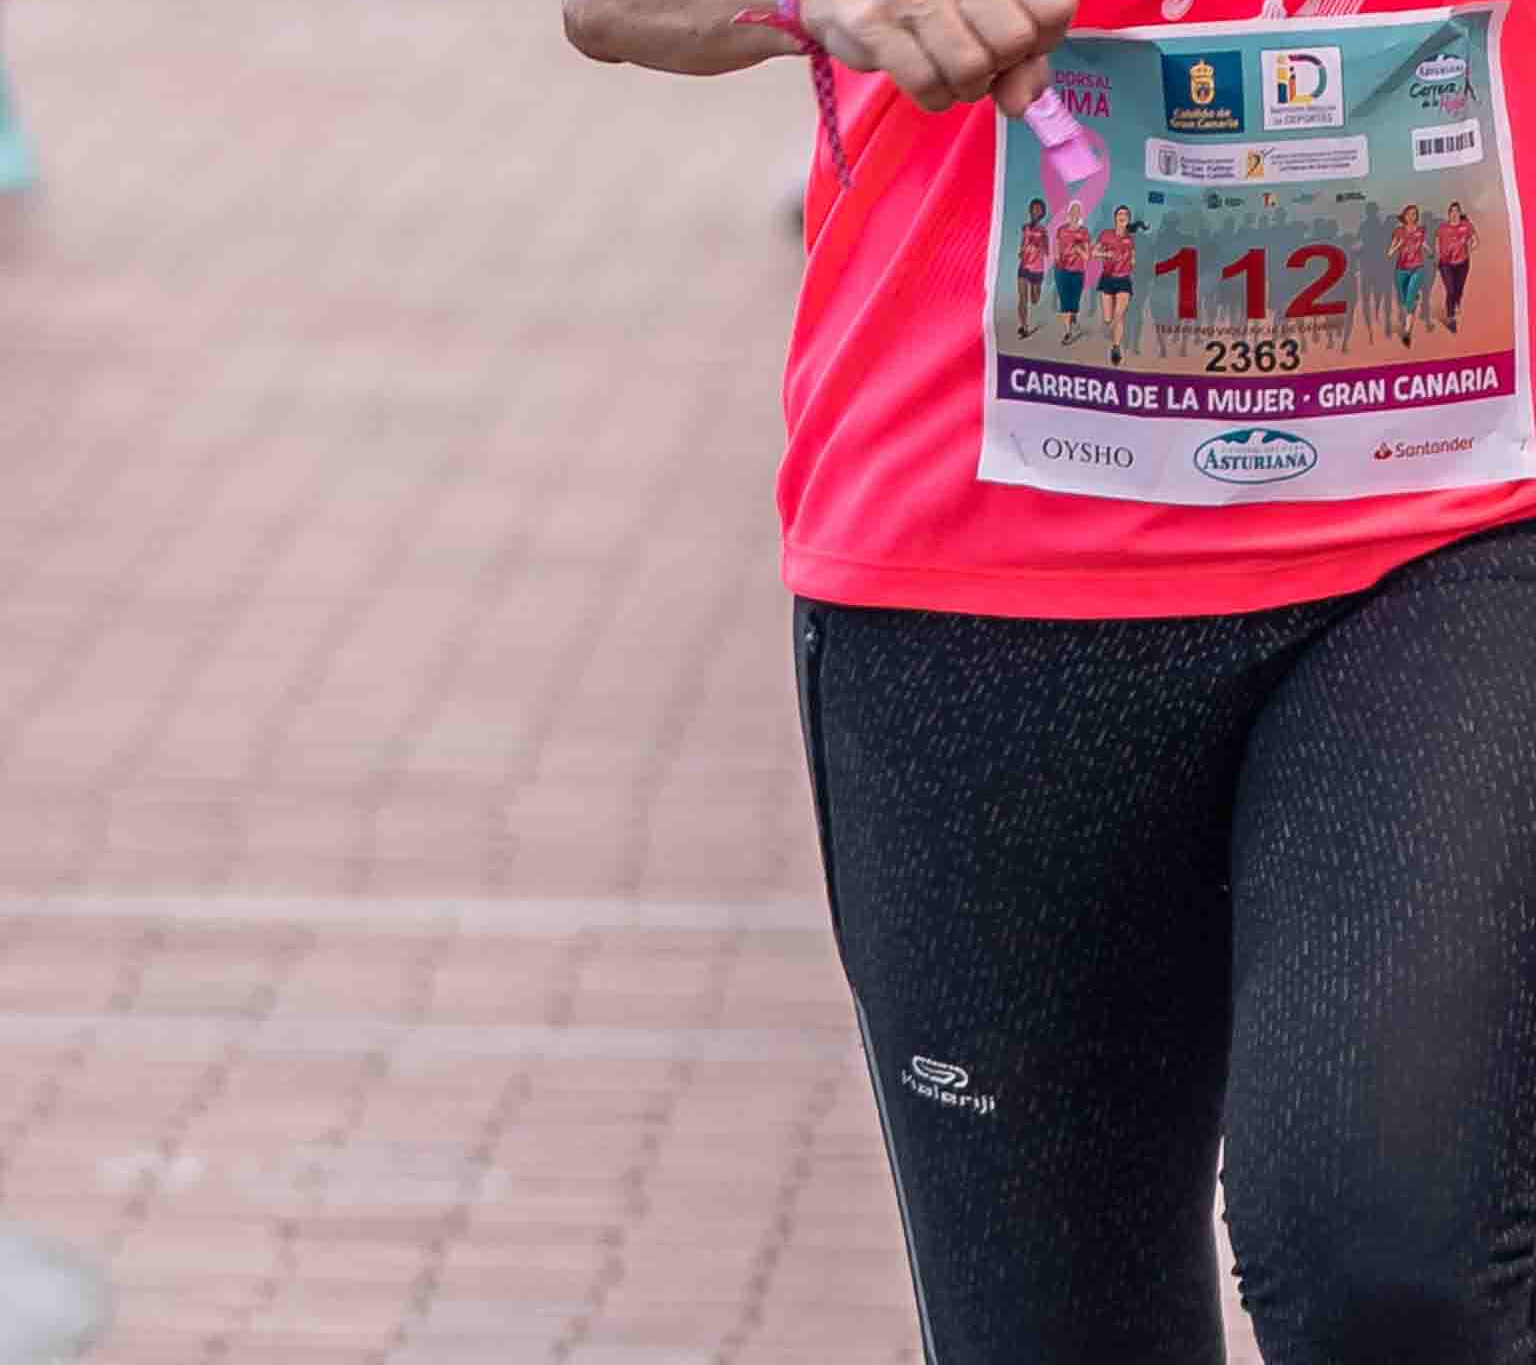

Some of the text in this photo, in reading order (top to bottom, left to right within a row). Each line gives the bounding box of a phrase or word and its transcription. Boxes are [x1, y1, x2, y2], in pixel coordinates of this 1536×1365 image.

[1156, 244, 1347, 320] 112
[1205, 340, 1300, 372] 2363
[1010, 365, 1499, 413] CARRERA DE LA MUJER GRAN CANARIA
[1042, 436, 1134, 469] OYSHO
[1203, 448, 1308, 470] ASTURIANA
[1394, 436, 1475, 459] Santander
